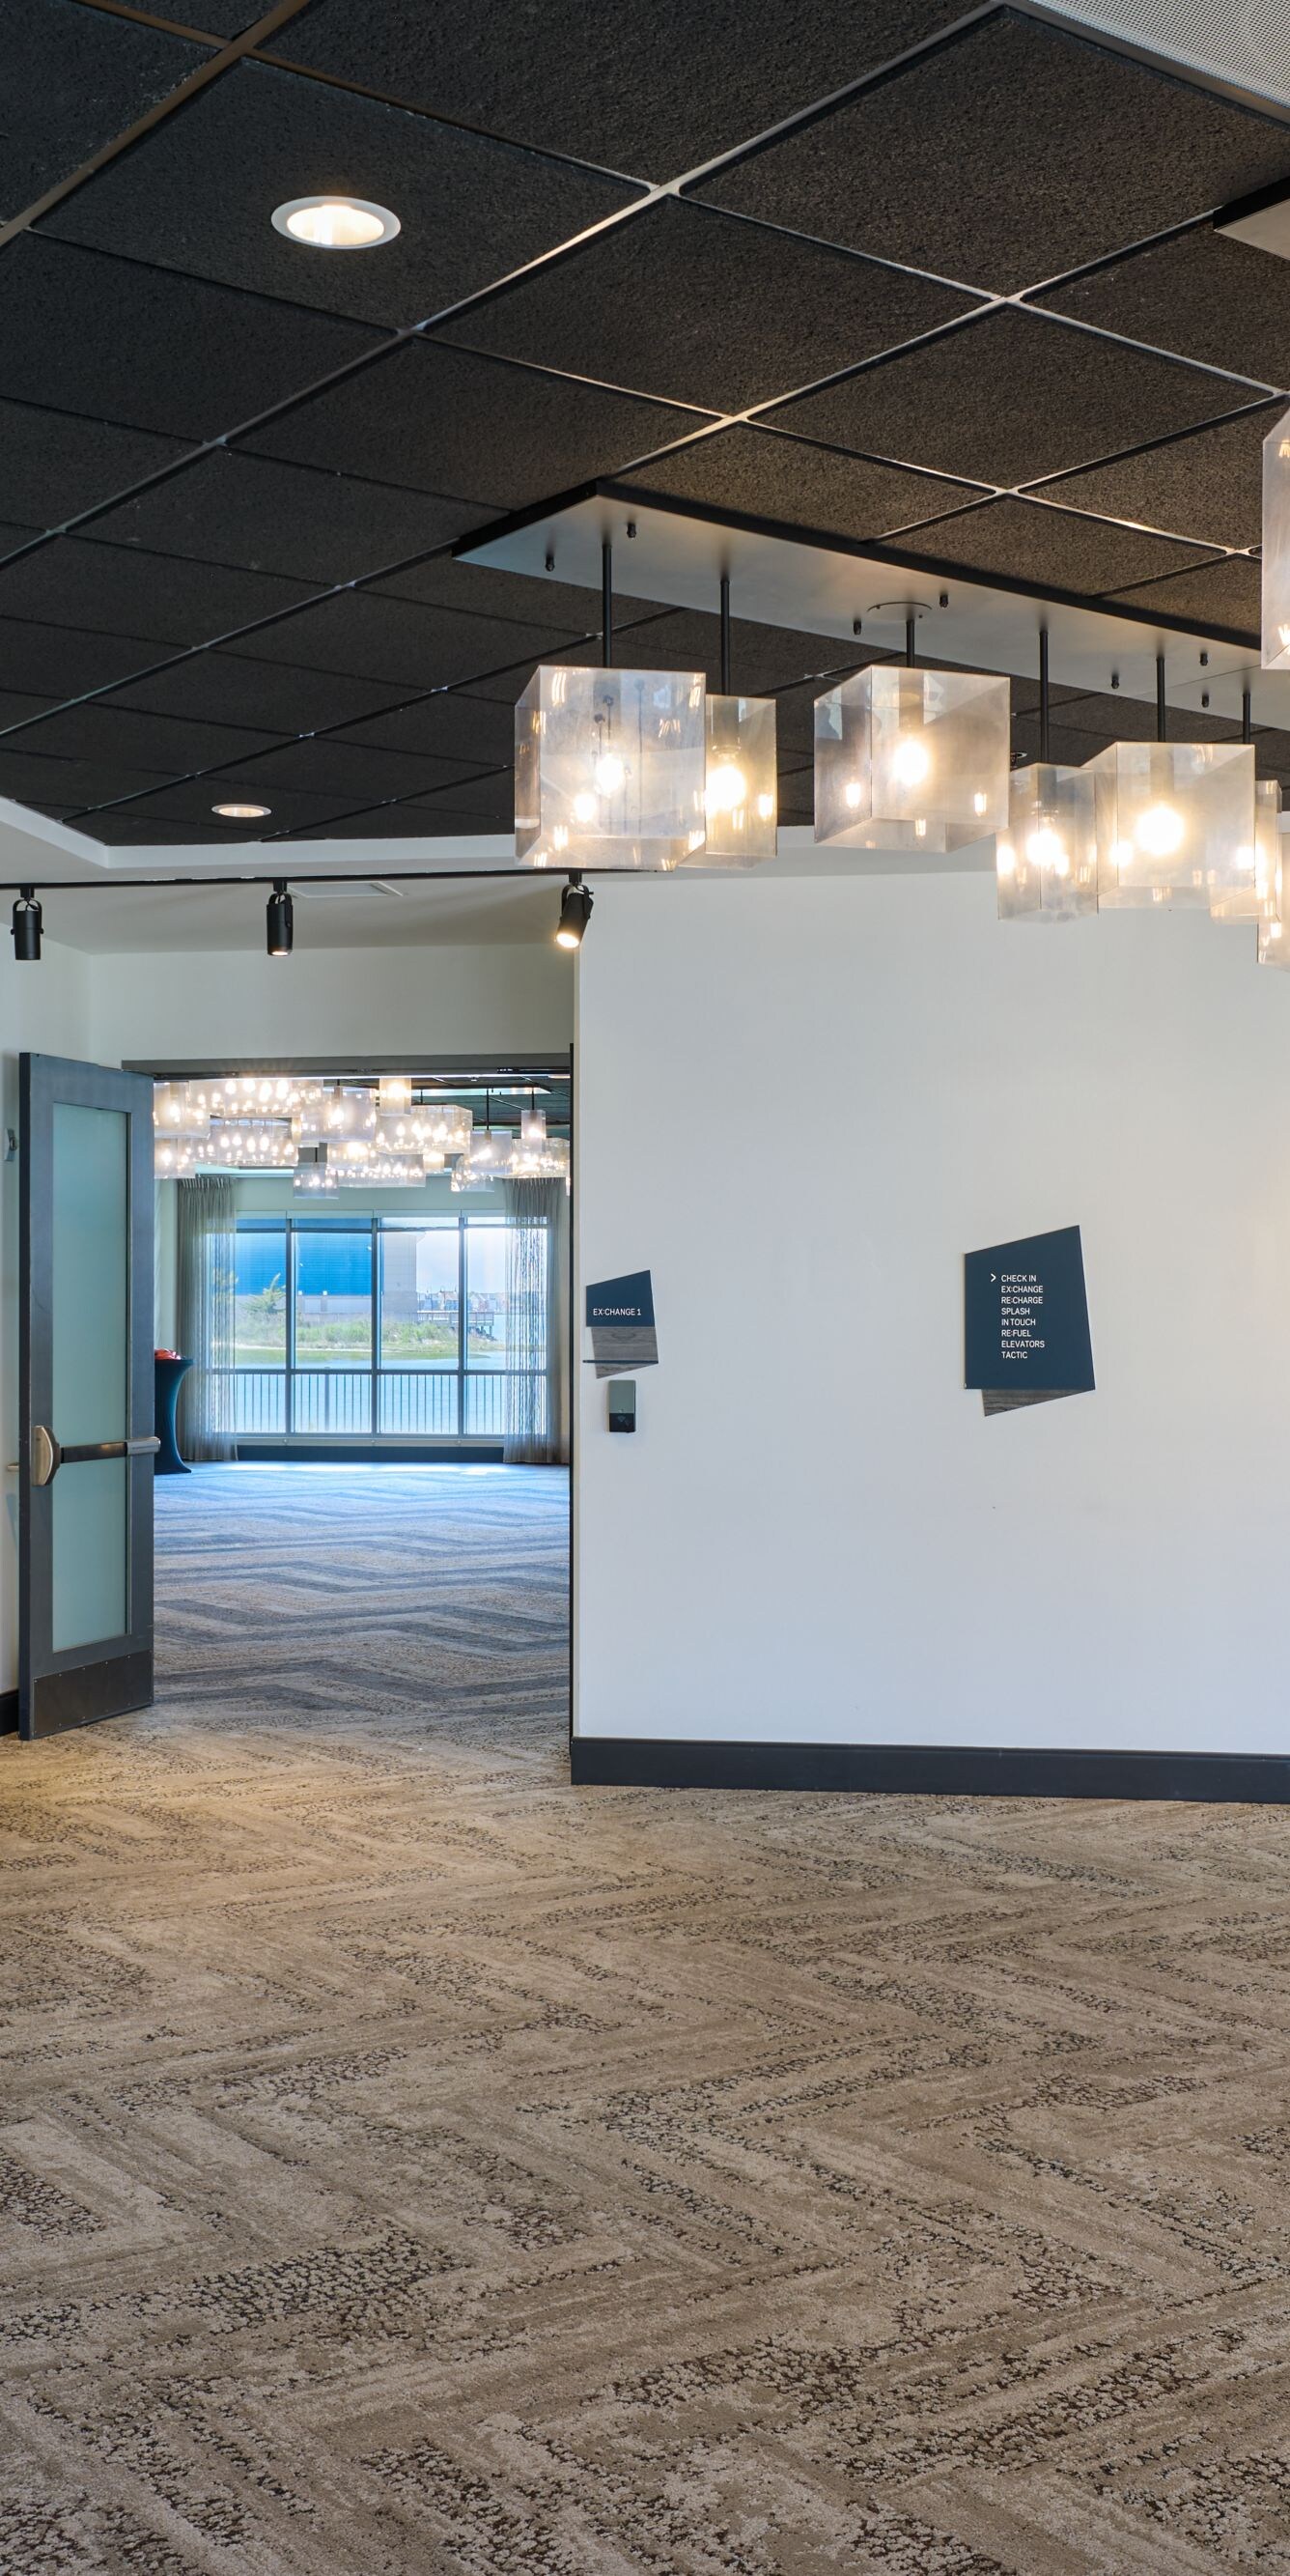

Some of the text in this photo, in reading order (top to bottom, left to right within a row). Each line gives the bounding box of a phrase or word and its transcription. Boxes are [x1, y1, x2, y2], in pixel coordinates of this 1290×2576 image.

[1000, 1274, 1037, 1283] CHECK IN
[636, 1308, 642, 1316] 1
[1000, 1307, 1030, 1316] SPLASH
[1000, 1317, 1036, 1326] IN TOUCH
[1000, 1340, 1046, 1348] ELEVATORS
[1000, 1350, 1028, 1359] TACTIC
